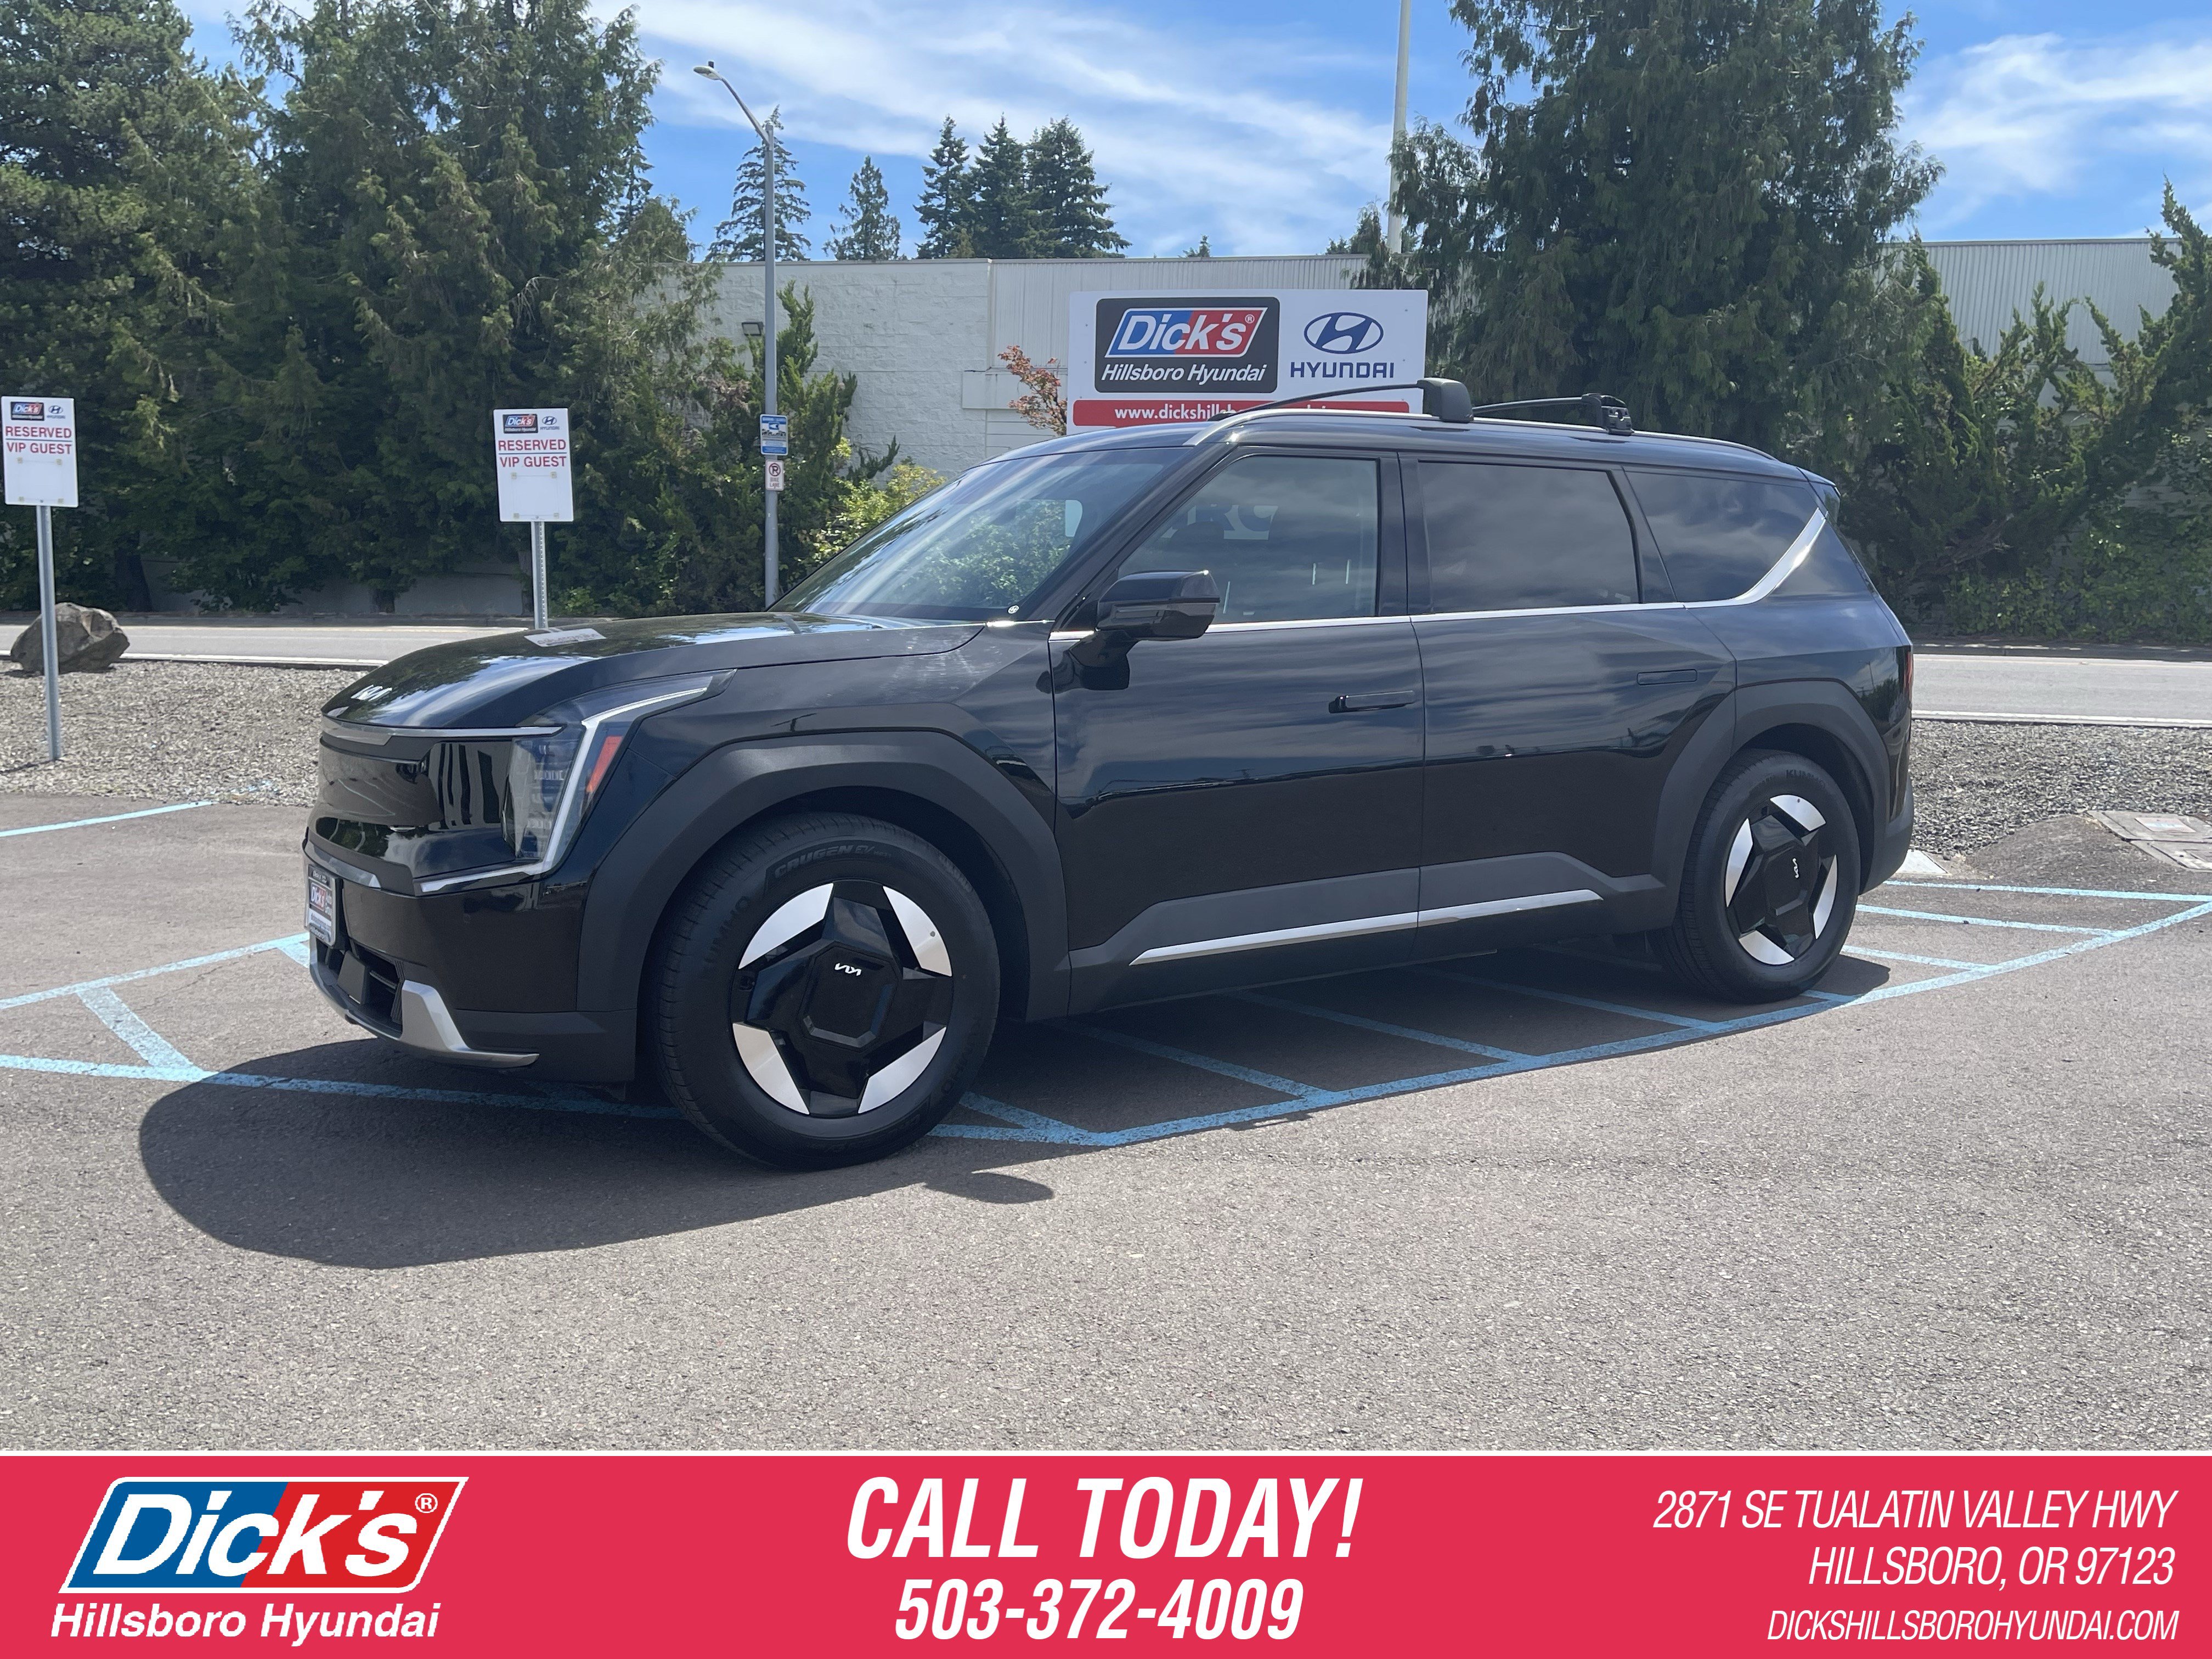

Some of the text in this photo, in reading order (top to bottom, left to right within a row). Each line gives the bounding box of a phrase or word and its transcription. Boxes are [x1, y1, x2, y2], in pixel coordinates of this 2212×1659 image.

[1116, 313, 1246, 351] Dick's
[1101, 364, 1267, 385] Hillsboro Hyundai
[1290, 362, 1394, 378] HYUNDAI
[5, 426, 72, 438] RESERVED
[7, 442, 71, 454] VIP GUEST
[498, 439, 566, 451] RESERVED
[500, 456, 567, 467] VIP GUEST
